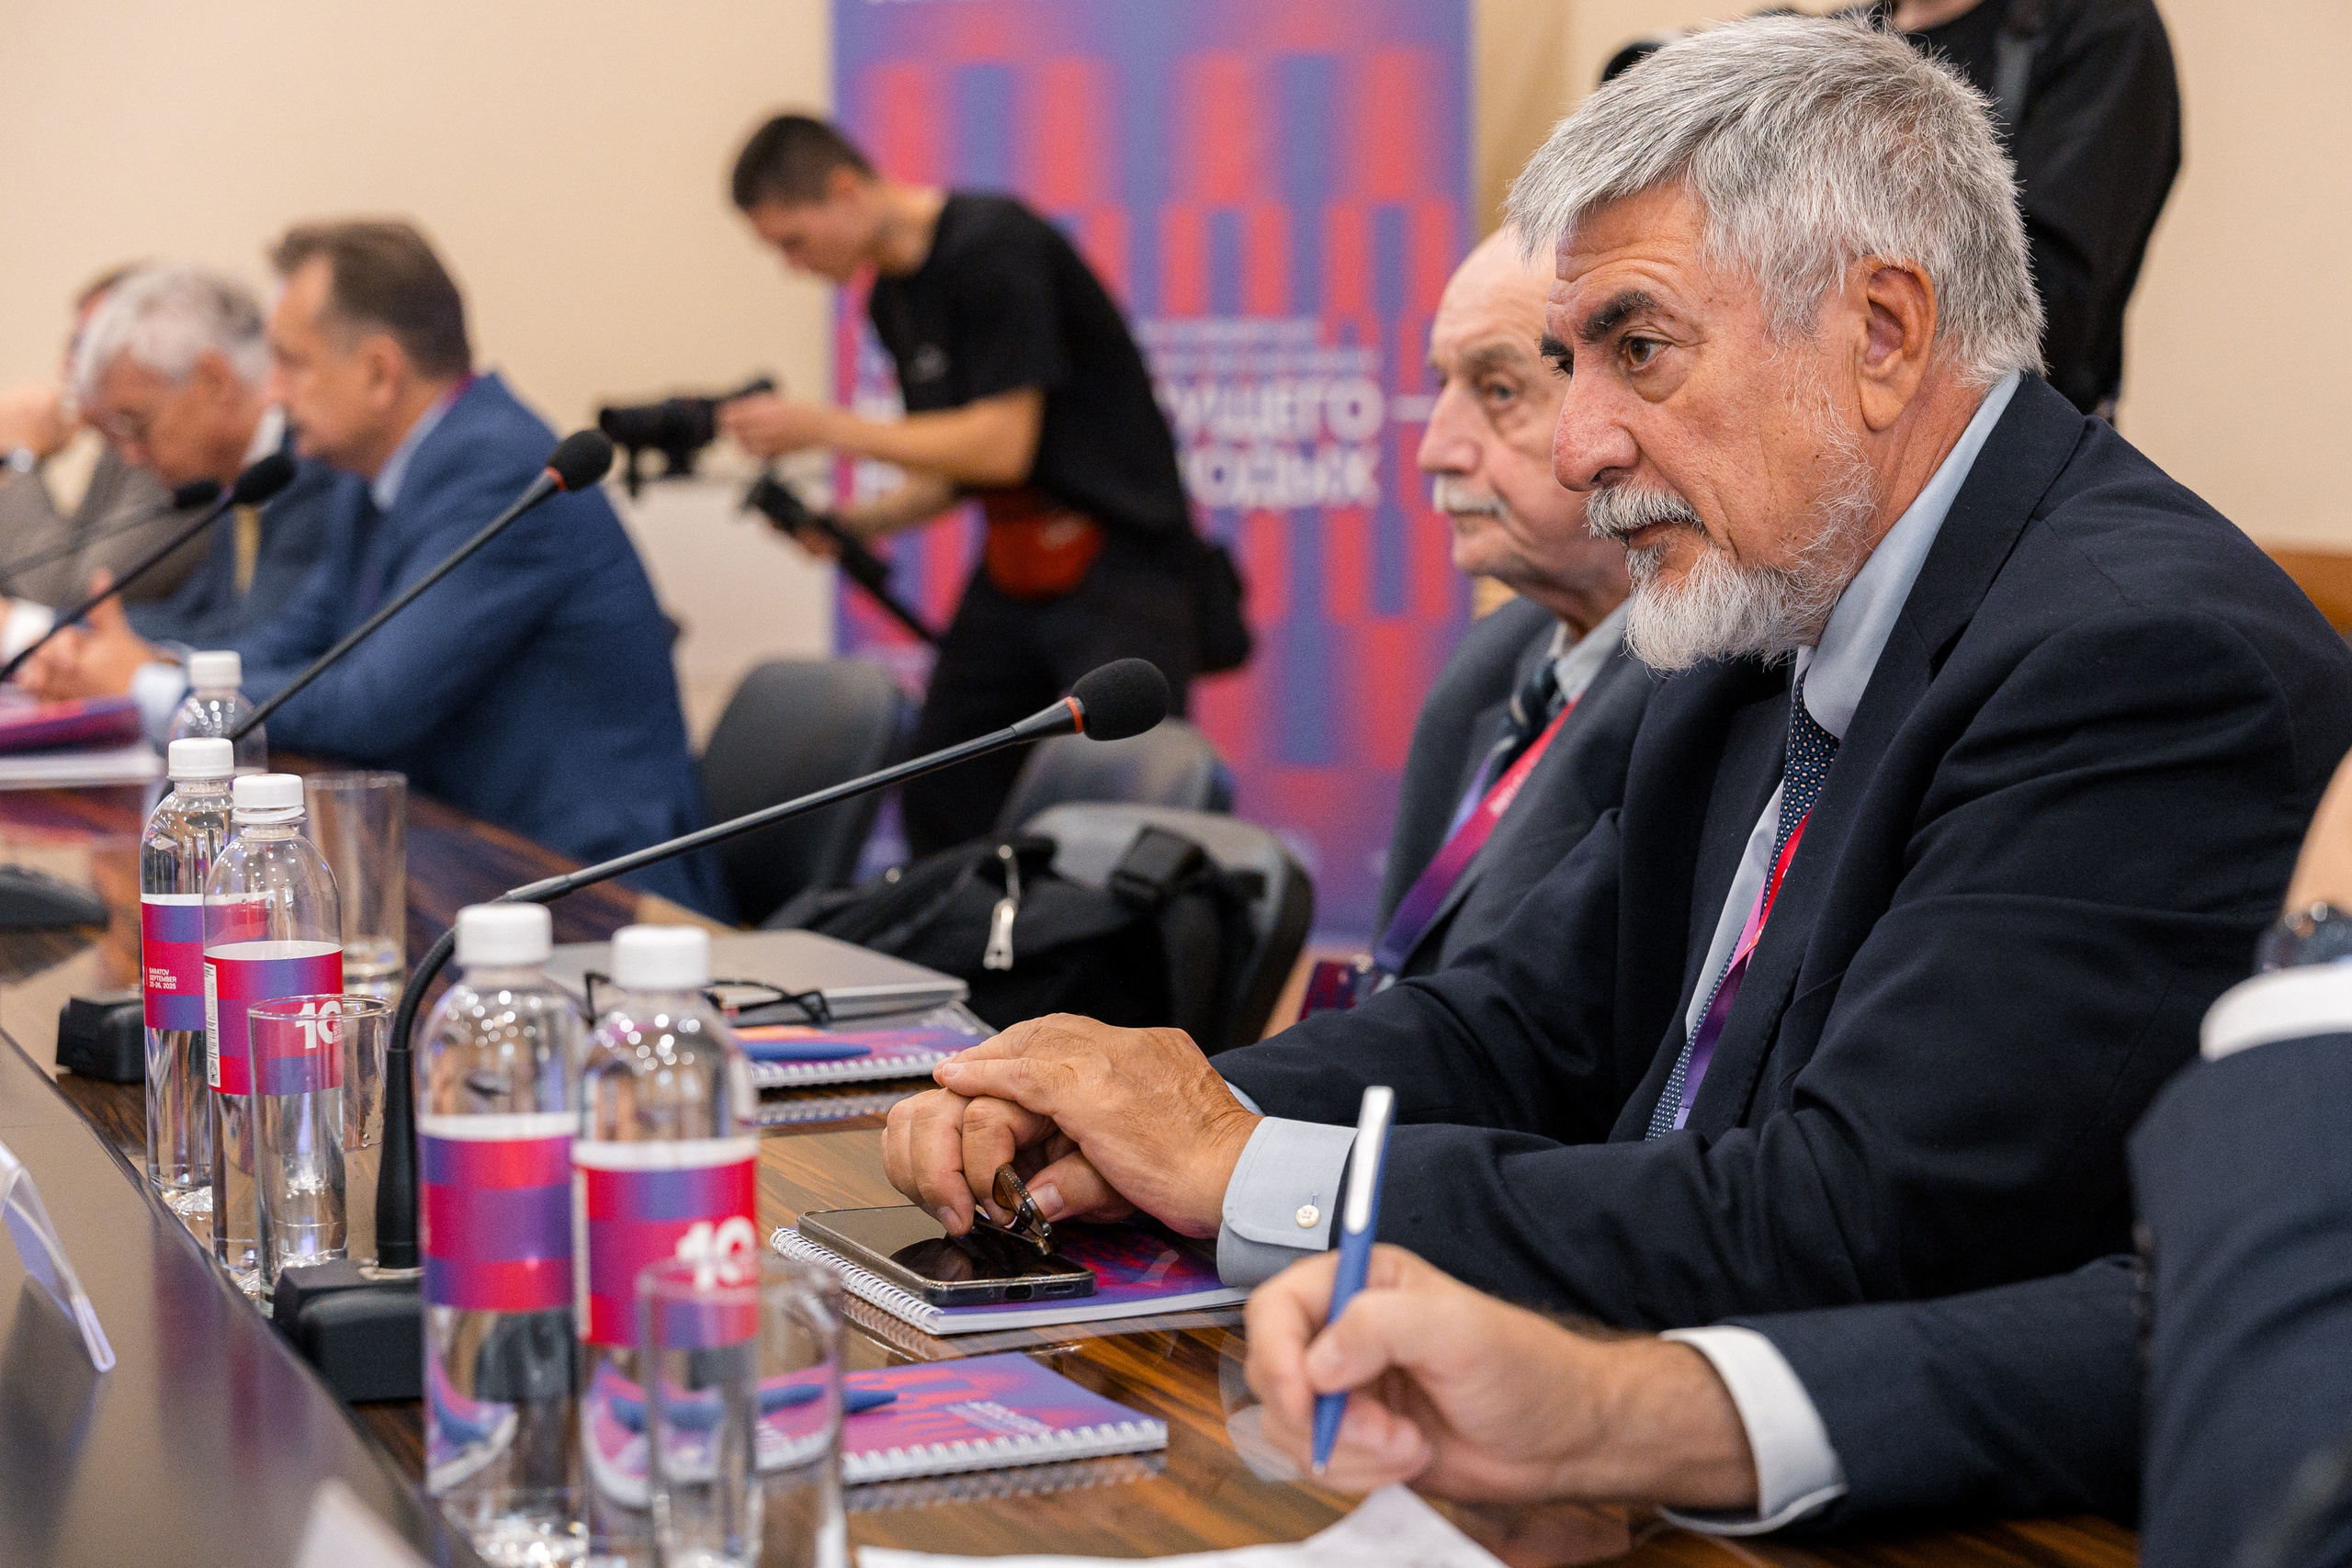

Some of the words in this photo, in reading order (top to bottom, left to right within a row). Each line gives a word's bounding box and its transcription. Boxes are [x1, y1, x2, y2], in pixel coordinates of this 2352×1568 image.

[149, 967, 170, 976] SARATOV
[149, 975, 177, 983] SEPTEMBER
[163, 982, 176, 990] 2025
